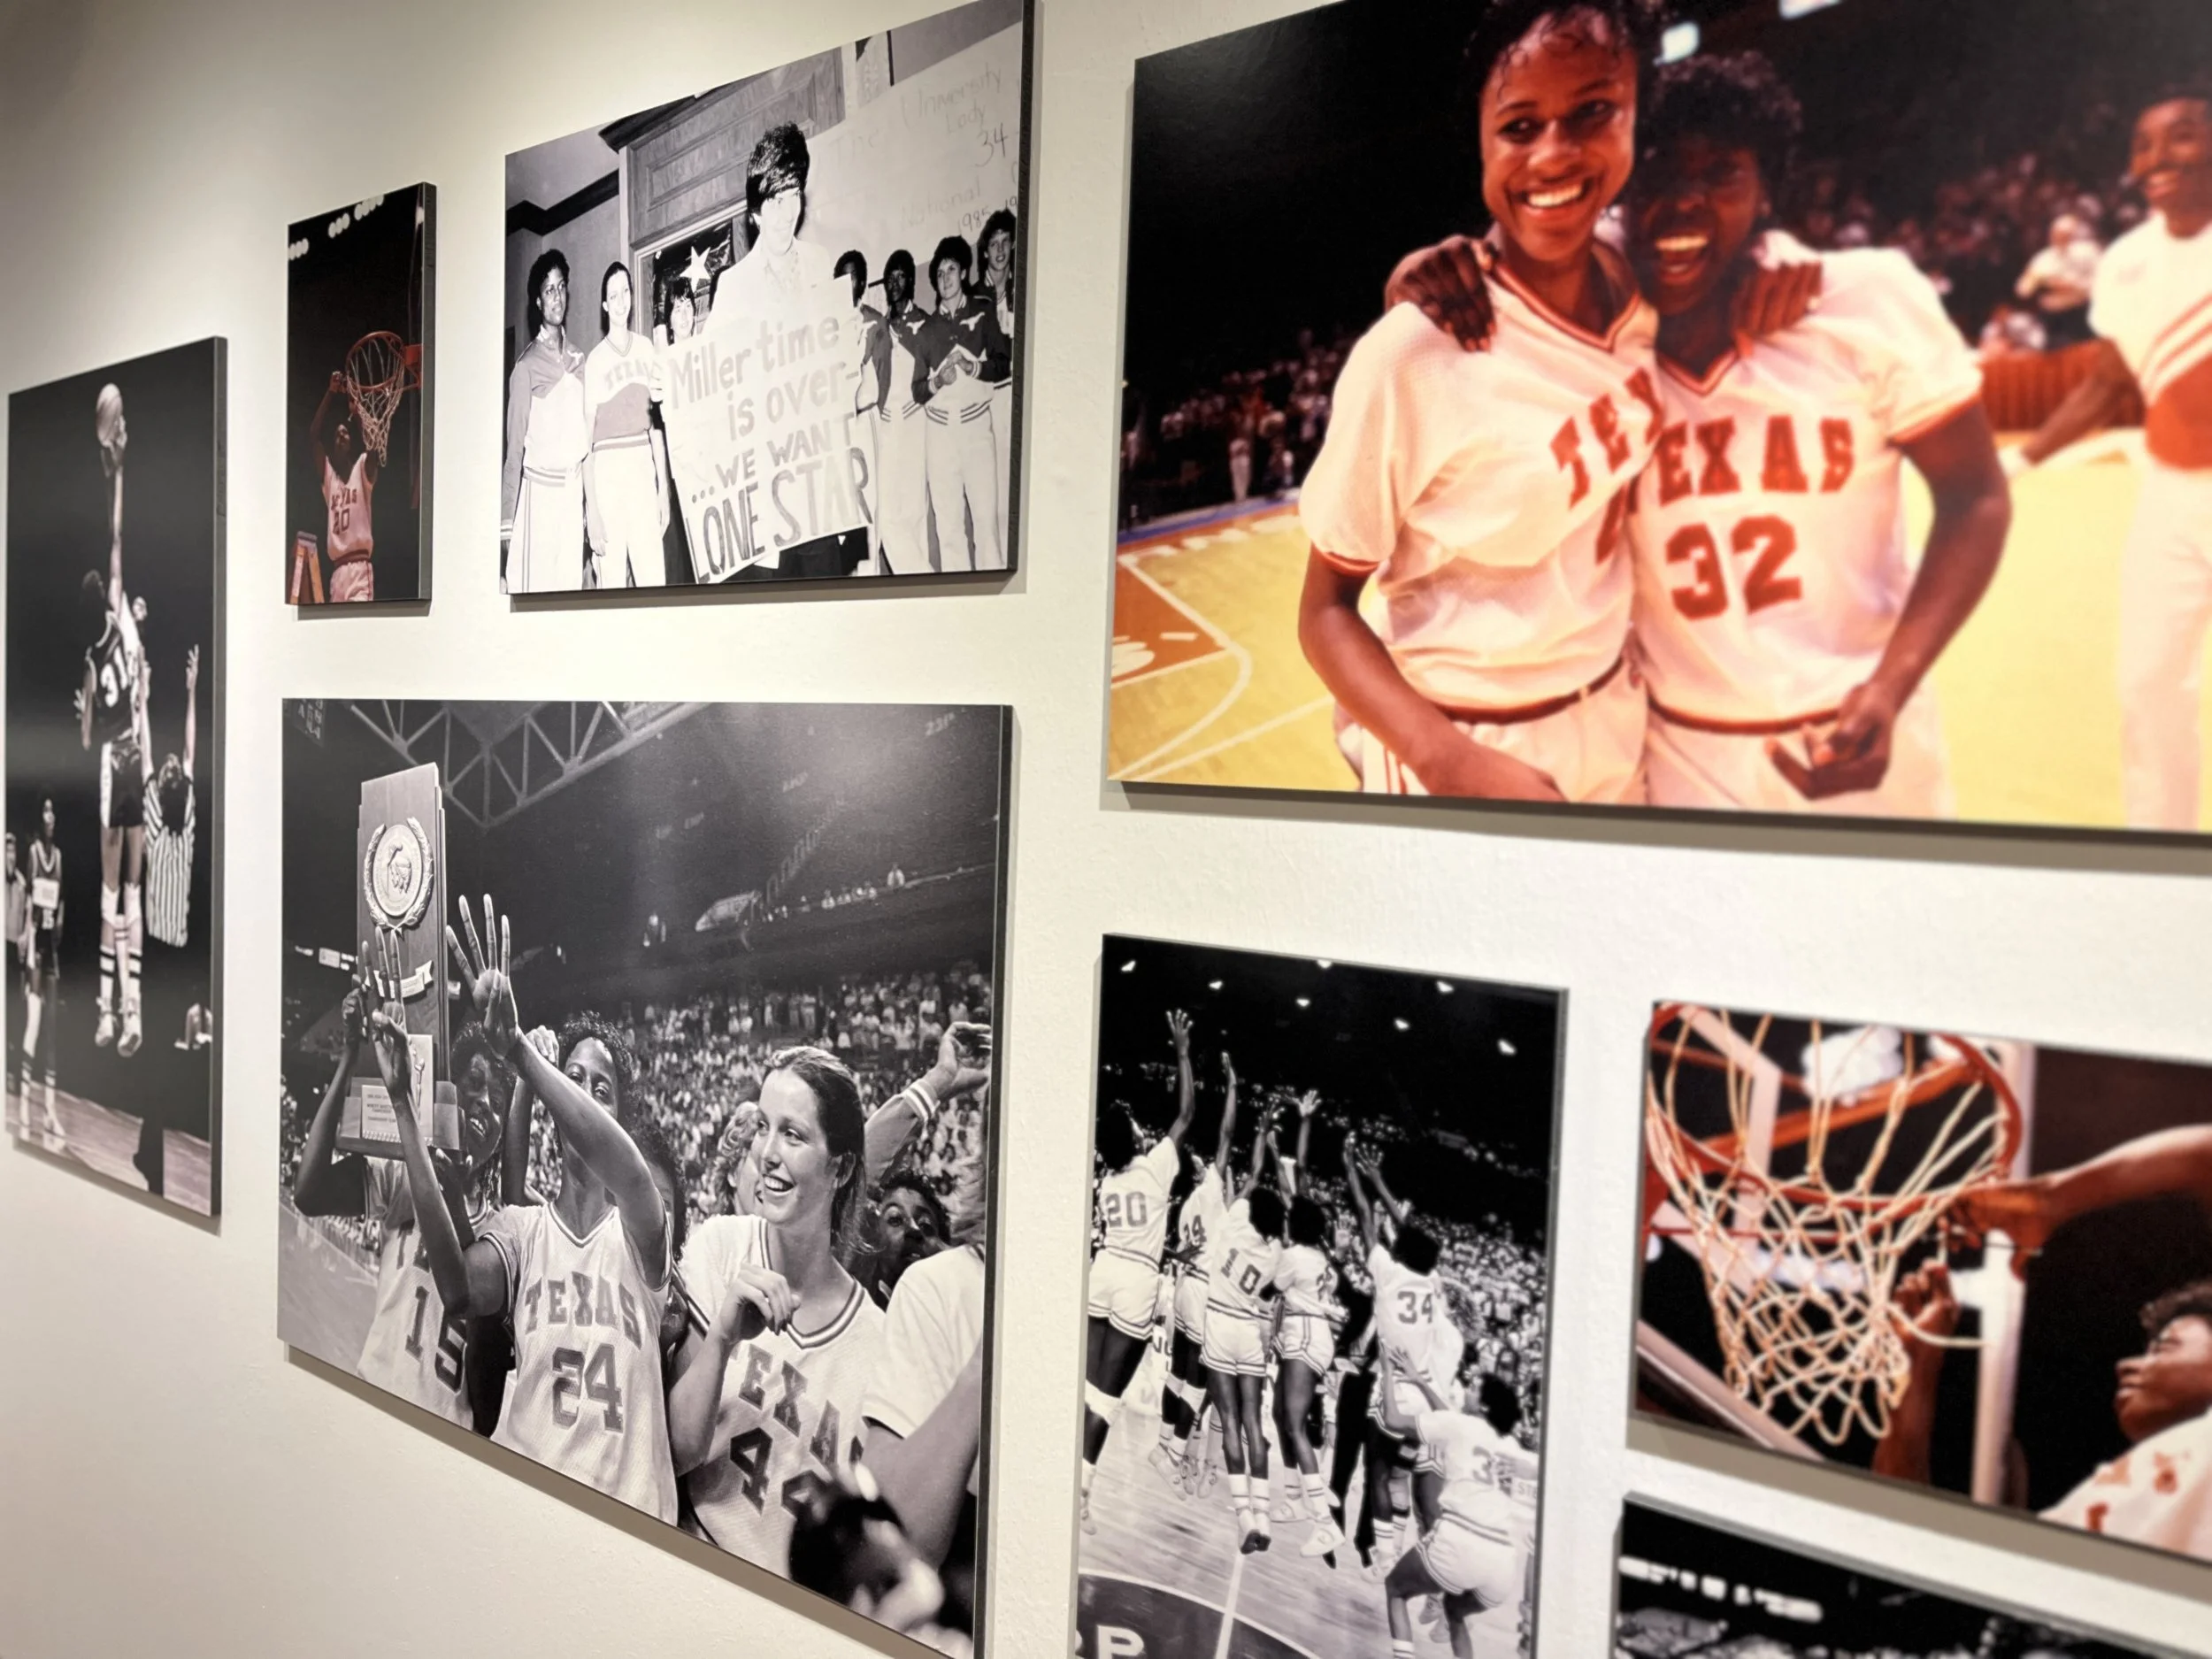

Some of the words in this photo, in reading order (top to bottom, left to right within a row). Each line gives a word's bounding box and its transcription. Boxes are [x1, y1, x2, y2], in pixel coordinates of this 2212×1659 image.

[667, 342, 753, 410] Miller
[756, 316, 840, 373] time
[727, 391, 755, 441] is
[766, 411, 856, 466] WANT
[685, 480, 765, 584] LONE
[772, 447, 872, 548] STAR
[1665, 514, 1803, 621] 32
[1106, 1191, 1148, 1228] 20
[1220, 1248, 1262, 1296] 10
[525, 1271, 642, 1351] TEXAS
[1397, 1291, 1433, 1325] 34
[552, 1343, 624, 1433] 24
